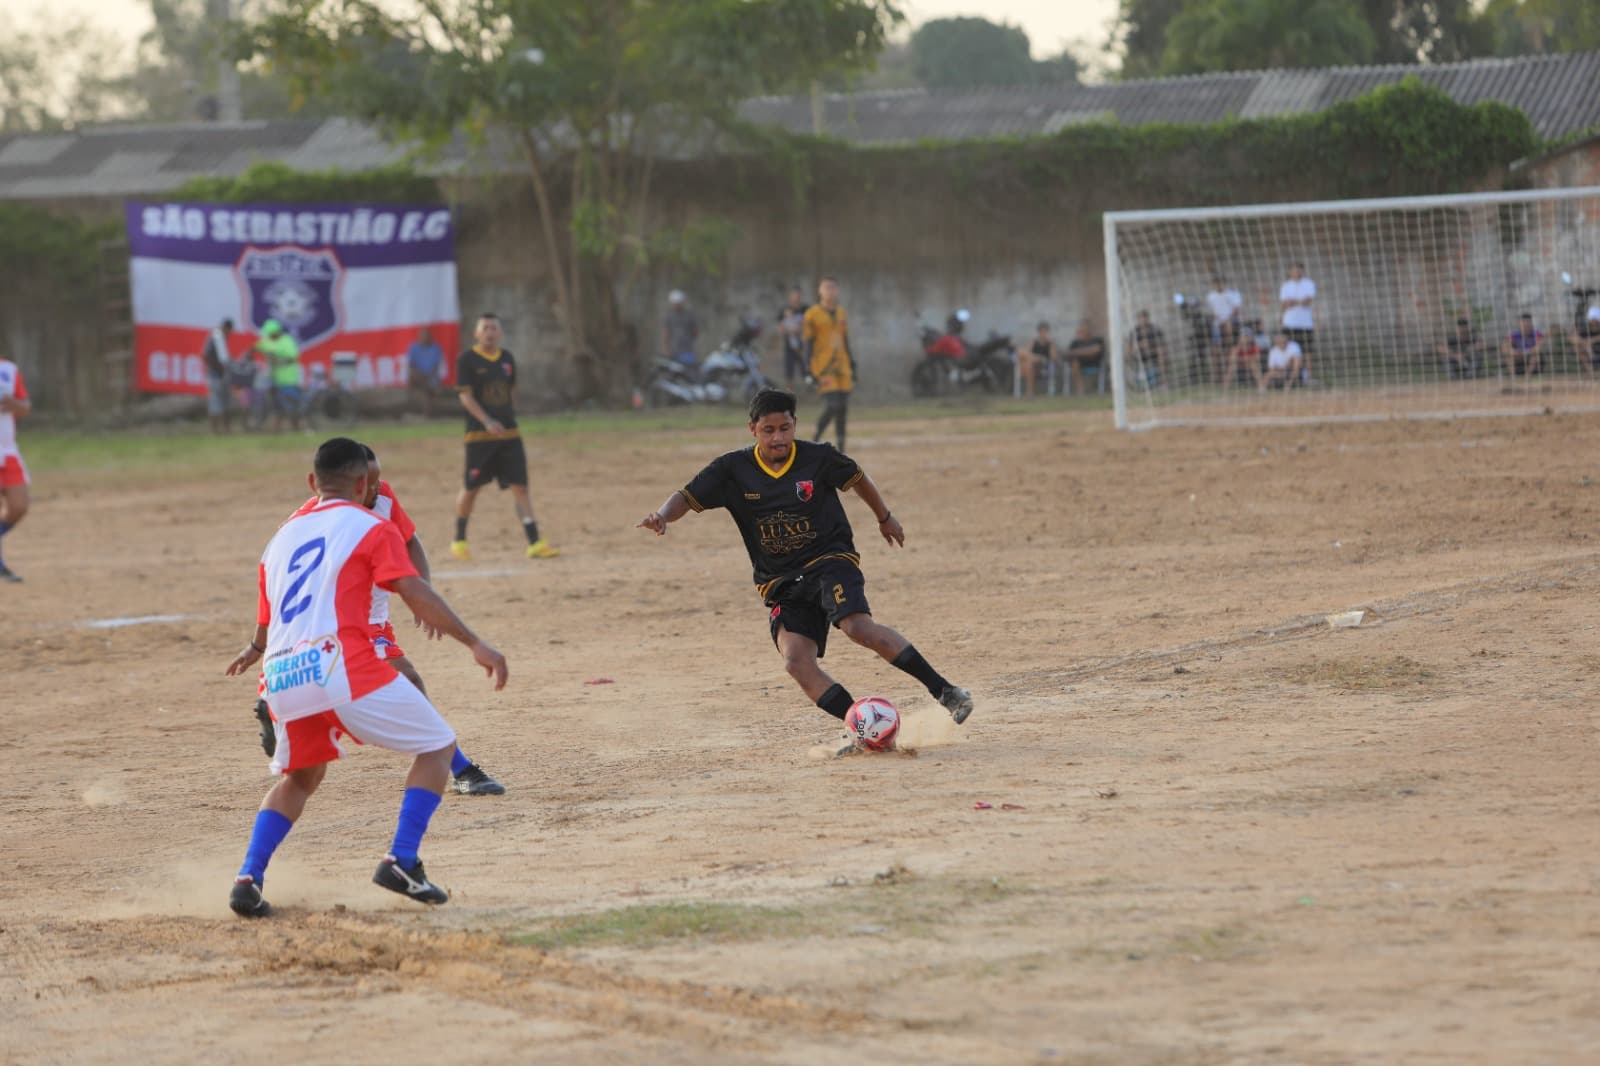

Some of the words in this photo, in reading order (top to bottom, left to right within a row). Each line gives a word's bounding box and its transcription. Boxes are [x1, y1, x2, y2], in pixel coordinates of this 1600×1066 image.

[142, 204, 206, 239] SÃO
[210, 208, 397, 244] SEBASTIÃO
[759, 519, 811, 540] LUXO
[281, 536, 326, 624] 2
[832, 583, 847, 605] 2
[266, 649, 320, 677] OBERTO
[267, 664, 323, 693] LAMITE
